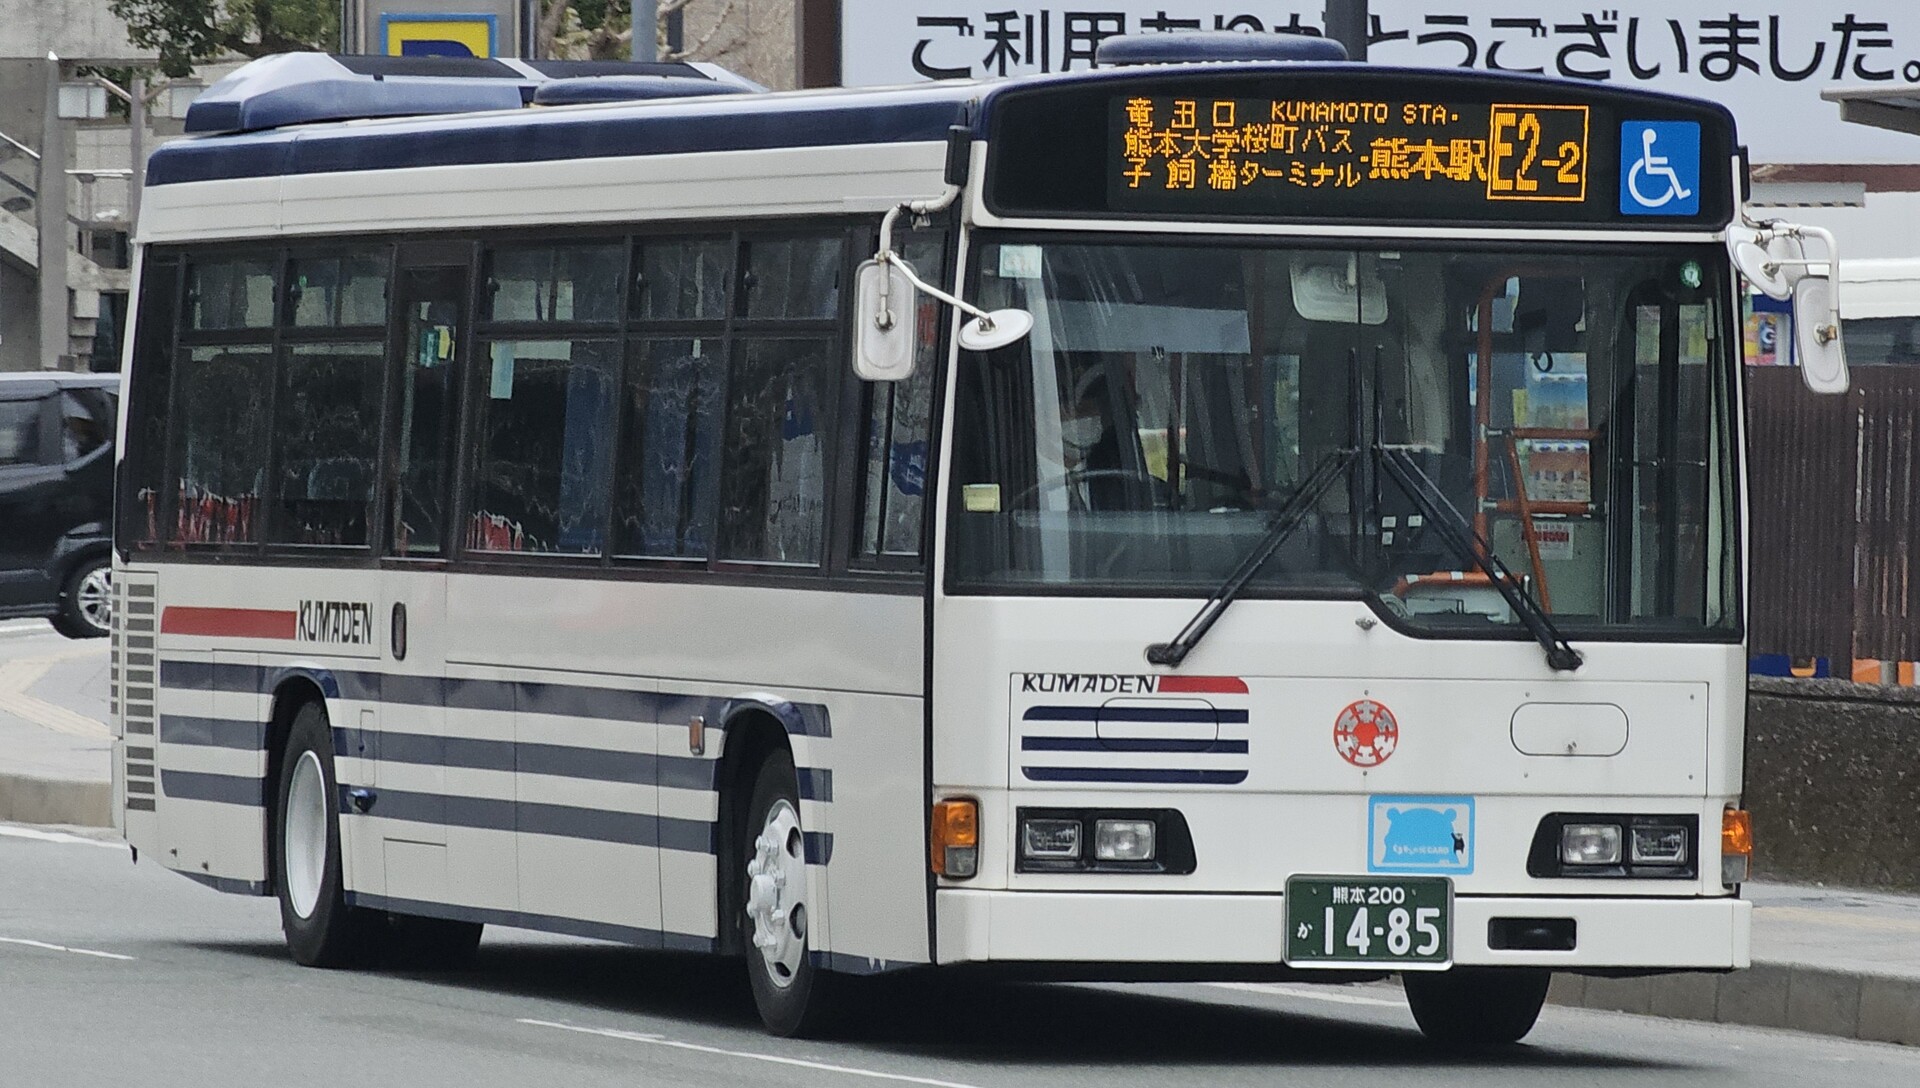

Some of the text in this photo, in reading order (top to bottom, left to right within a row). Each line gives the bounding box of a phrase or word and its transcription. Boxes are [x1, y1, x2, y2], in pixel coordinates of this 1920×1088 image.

[1271, 101, 1460, 125] KUMAMOTO STA.
[1492, 112, 1581, 192] E2-2
[298, 600, 373, 645] KUMADEN
[1022, 673, 1157, 694] KUMADEN
[1296, 906, 1441, 956] か 14-85
